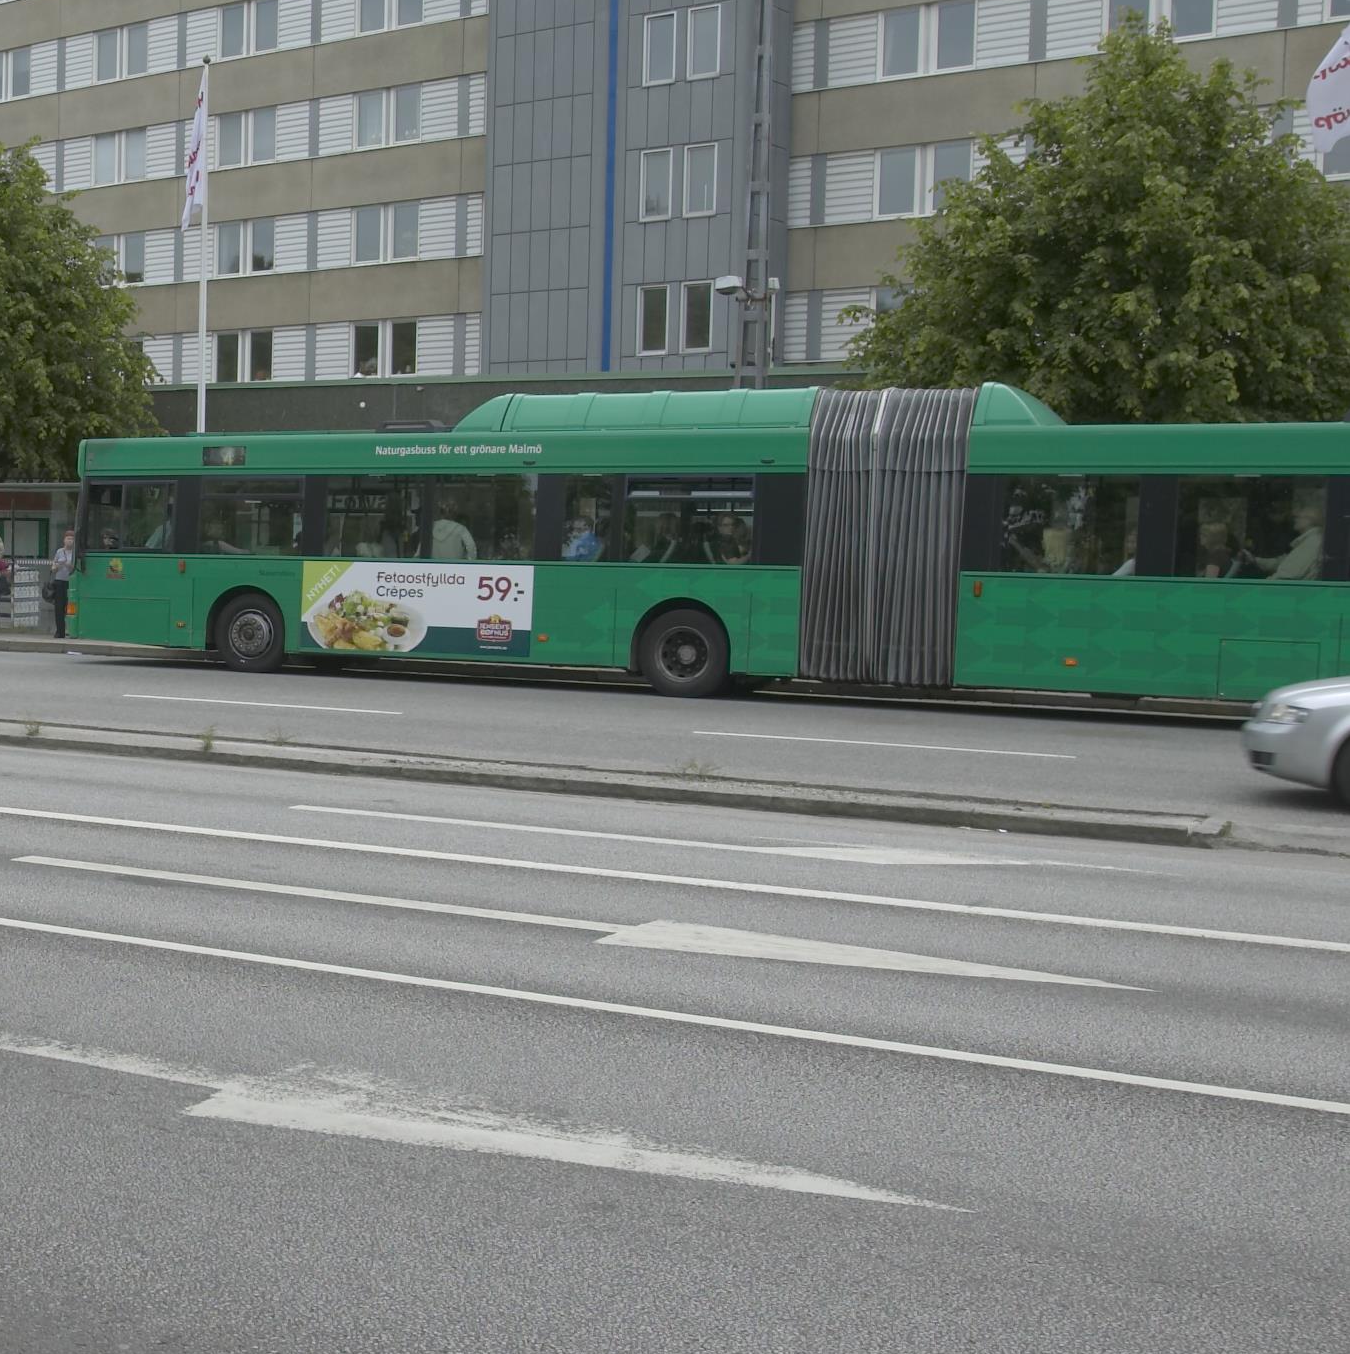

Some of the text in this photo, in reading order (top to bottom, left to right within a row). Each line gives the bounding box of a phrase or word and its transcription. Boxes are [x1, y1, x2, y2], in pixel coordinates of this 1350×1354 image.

[375, 444, 542, 456] Naturgasbuss för ett grönare Malmö
[306, 564, 341, 602] NYHET!
[376, 572, 465, 588] Fetaostfyllda
[476, 576, 525, 602] 59:-
